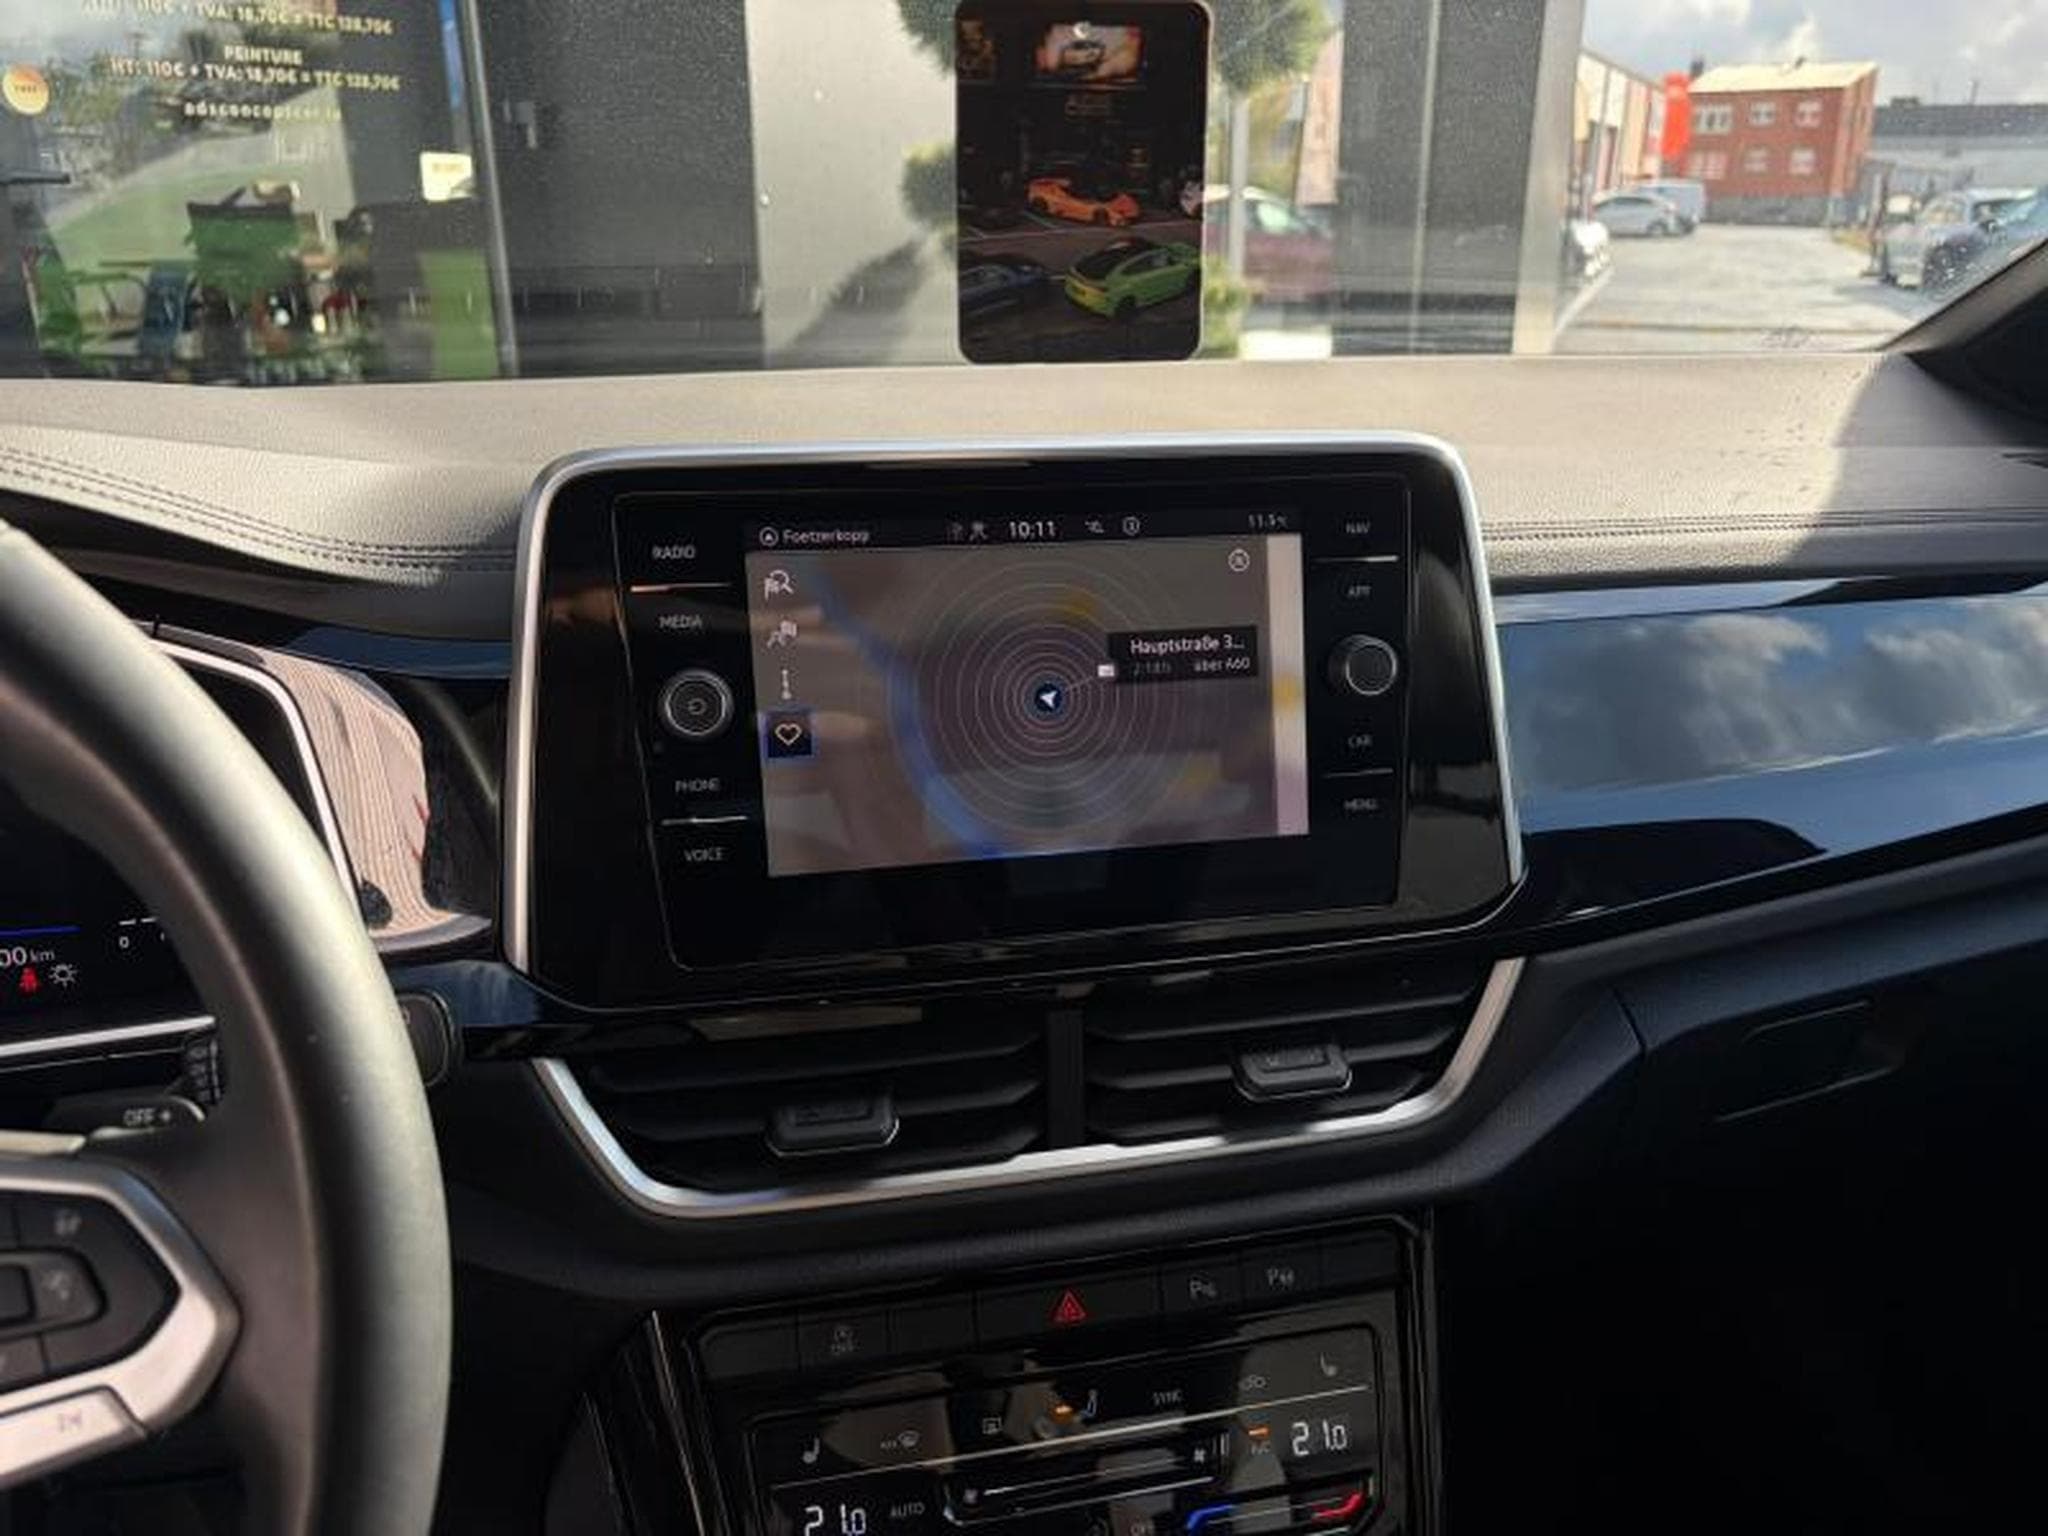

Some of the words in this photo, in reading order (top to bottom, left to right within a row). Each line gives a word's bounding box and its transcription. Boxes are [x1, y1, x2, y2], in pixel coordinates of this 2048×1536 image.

[224, 44, 303, 65] PEINTURE
[1009, 520, 1056, 539] 10:11
[1130, 635, 1220, 656] Hauptstraße
